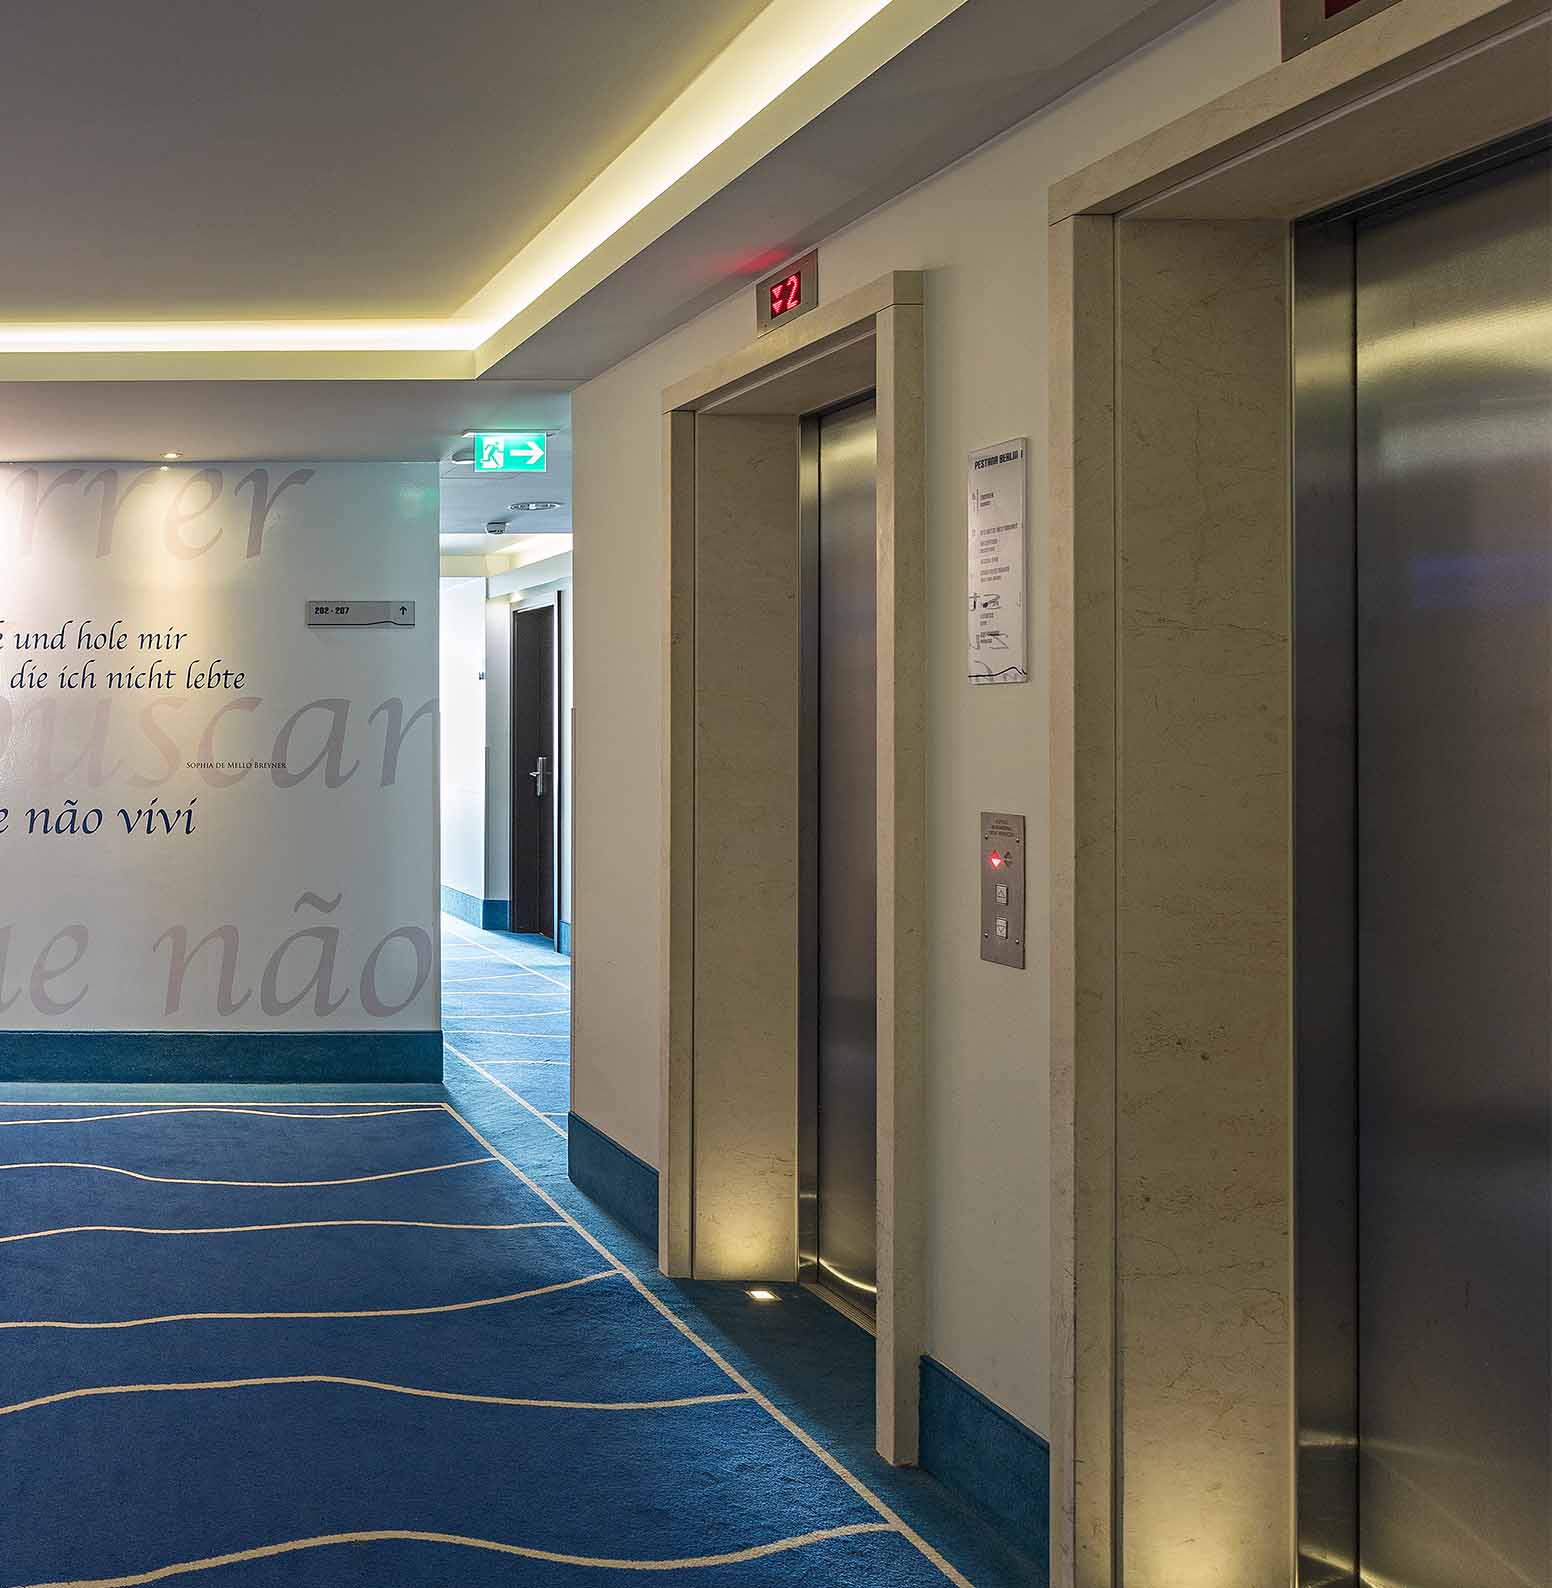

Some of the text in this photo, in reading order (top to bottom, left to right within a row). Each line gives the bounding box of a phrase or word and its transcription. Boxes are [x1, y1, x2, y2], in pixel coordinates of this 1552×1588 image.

[786, 274, 799, 310] 2
[314, 606, 330, 616] 202
[334, 606, 350, 616] 207
[14, 620, 74, 650] und
[77, 620, 128, 650] hole
[137, 626, 189, 650] mir
[10, 659, 48, 689] die
[57, 659, 97, 689] ich
[106, 659, 177, 689] nicht
[186, 659, 246, 689] lebte
[186, 761, 214, 769] SOPHIA
[24, 799, 104, 835] não
[153, 893, 435, 1017] não
